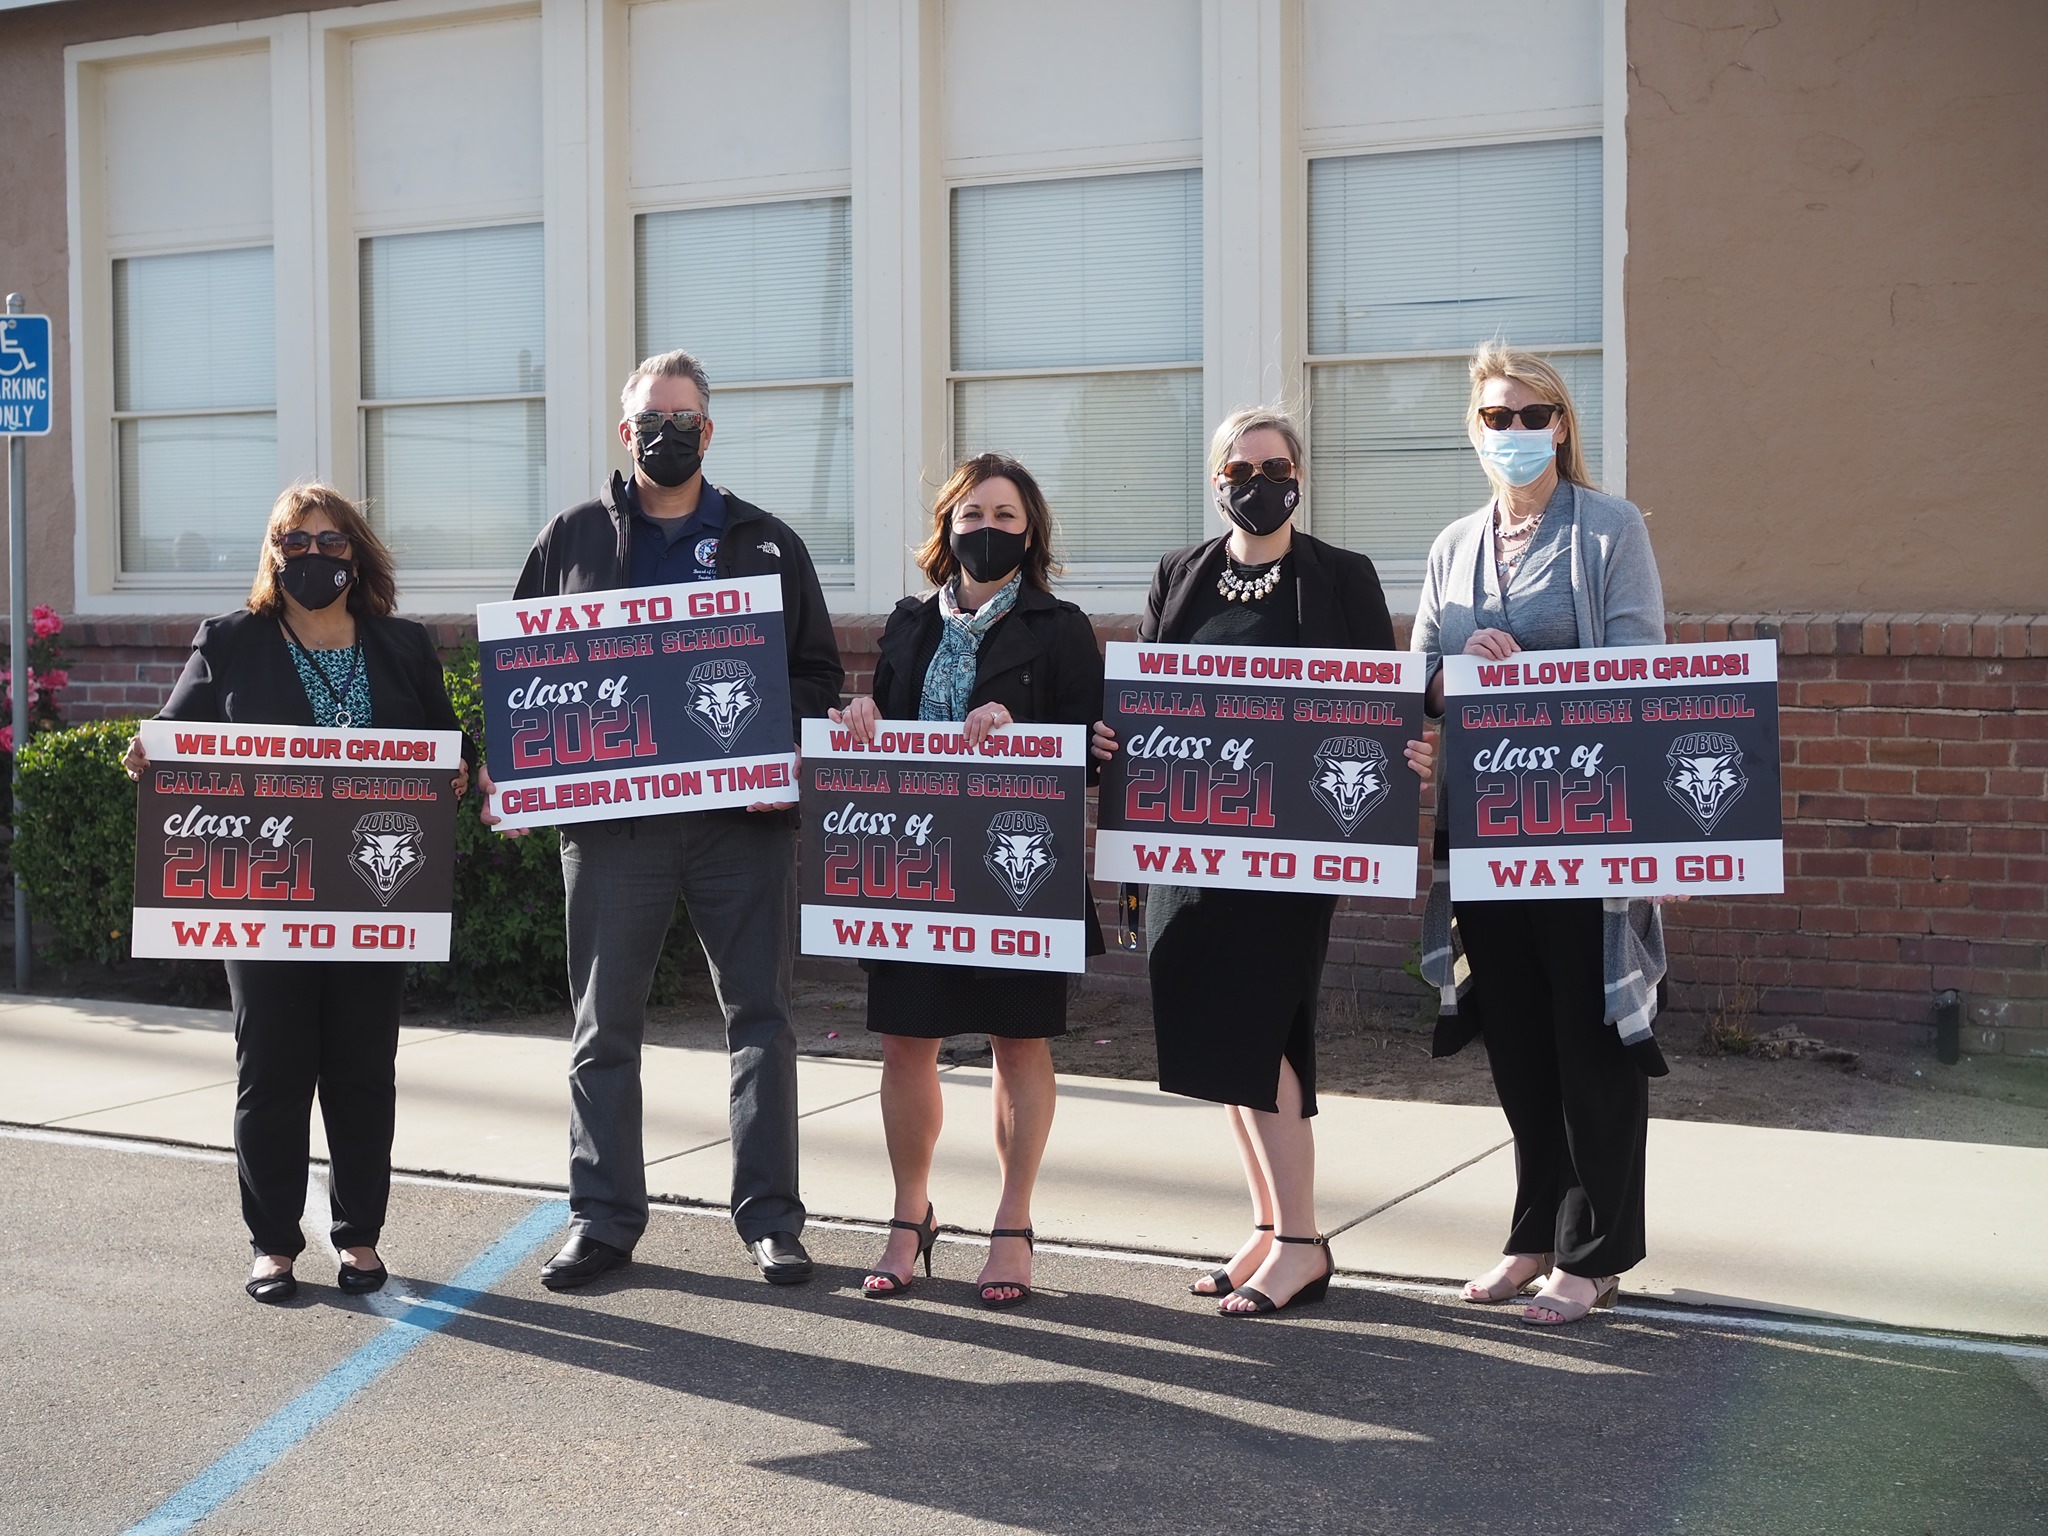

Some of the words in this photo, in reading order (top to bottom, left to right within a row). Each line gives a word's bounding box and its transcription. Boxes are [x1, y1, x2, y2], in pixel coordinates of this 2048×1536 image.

[0, 377, 47, 400] RKING
[516, 603, 605, 635] WAY
[621, 597, 672, 624] TO
[688, 590, 751, 617] GO!
[495, 642, 579, 670] CALLA
[588, 634, 653, 661] HIGH
[661, 623, 765, 653] SCHOOL
[693, 660, 750, 681] LOBOS
[1138, 652, 1178, 674] WE
[1182, 655, 1246, 677] LOVE
[1251, 657, 1302, 679] OUR
[1308, 660, 1401, 684] GRADS!
[1478, 665, 1519, 687] WE
[1524, 661, 1590, 684] LOVE
[1594, 658, 1647, 681] OUR
[1653, 654, 1749, 680] GRADS!
[507, 676, 588, 710] class
[598, 675, 628, 708] of
[1119, 690, 1205, 717] CALLA
[1216, 694, 1284, 721] HIGH
[1294, 698, 1402, 726] SCHOOL
[1462, 703, 1551, 729] CALLA
[1562, 699, 1632, 725] HIGH
[1642, 694, 1754, 721] SCHOOL
[175, 733, 216, 755] WE
[220, 736, 285, 758] LOVE
[290, 738, 342, 759] OUR
[346, 739, 437, 761] GRADS!
[511, 694, 657, 770] 2021
[867, 732, 925, 753] LOVE
[928, 734, 975, 755] OUR
[979, 735, 1062, 758] GRADS!
[1126, 726, 1211, 759] class
[1221, 738, 1254, 771] of
[1320, 738, 1381, 758] LOBOS
[1671, 734, 1736, 755] LOBOS
[1473, 738, 1560, 773] class
[1571, 743, 1603, 777] of
[155, 771, 244, 796] CALLA
[254, 774, 323, 798] HIGH
[332, 776, 437, 800] SCHOOL
[501, 771, 702, 814] CELEBRATION
[707, 762, 790, 792] TIME!
[815, 768, 890, 793] CALLA
[898, 771, 959, 795] HIGH
[967, 773, 1065, 799] SCHOOL
[1125, 757, 1275, 827] 2021
[1476, 766, 1632, 836] 2021
[164, 805, 250, 838] class
[260, 815, 293, 847] of
[361, 813, 419, 832] LOBOS
[823, 802, 896, 835] class
[905, 813, 933, 846] of
[992, 812, 1047, 832] LOBOS
[163, 836, 315, 901] 2021
[824, 833, 955, 902] 2021
[1133, 845, 1225, 875] WAY
[1243, 851, 1296, 879] TO
[1314, 854, 1380, 884] GO!
[1488, 858, 1583, 887] WAY
[1601, 857, 1657, 884] TO
[1676, 854, 1745, 881] GO!
[172, 921, 265, 947] WAY
[283, 924, 336, 949] TO
[353, 925, 416, 950] GO!
[833, 919, 912, 948] WAY
[928, 925, 975, 952] TO
[991, 928, 1051, 958] GO!
